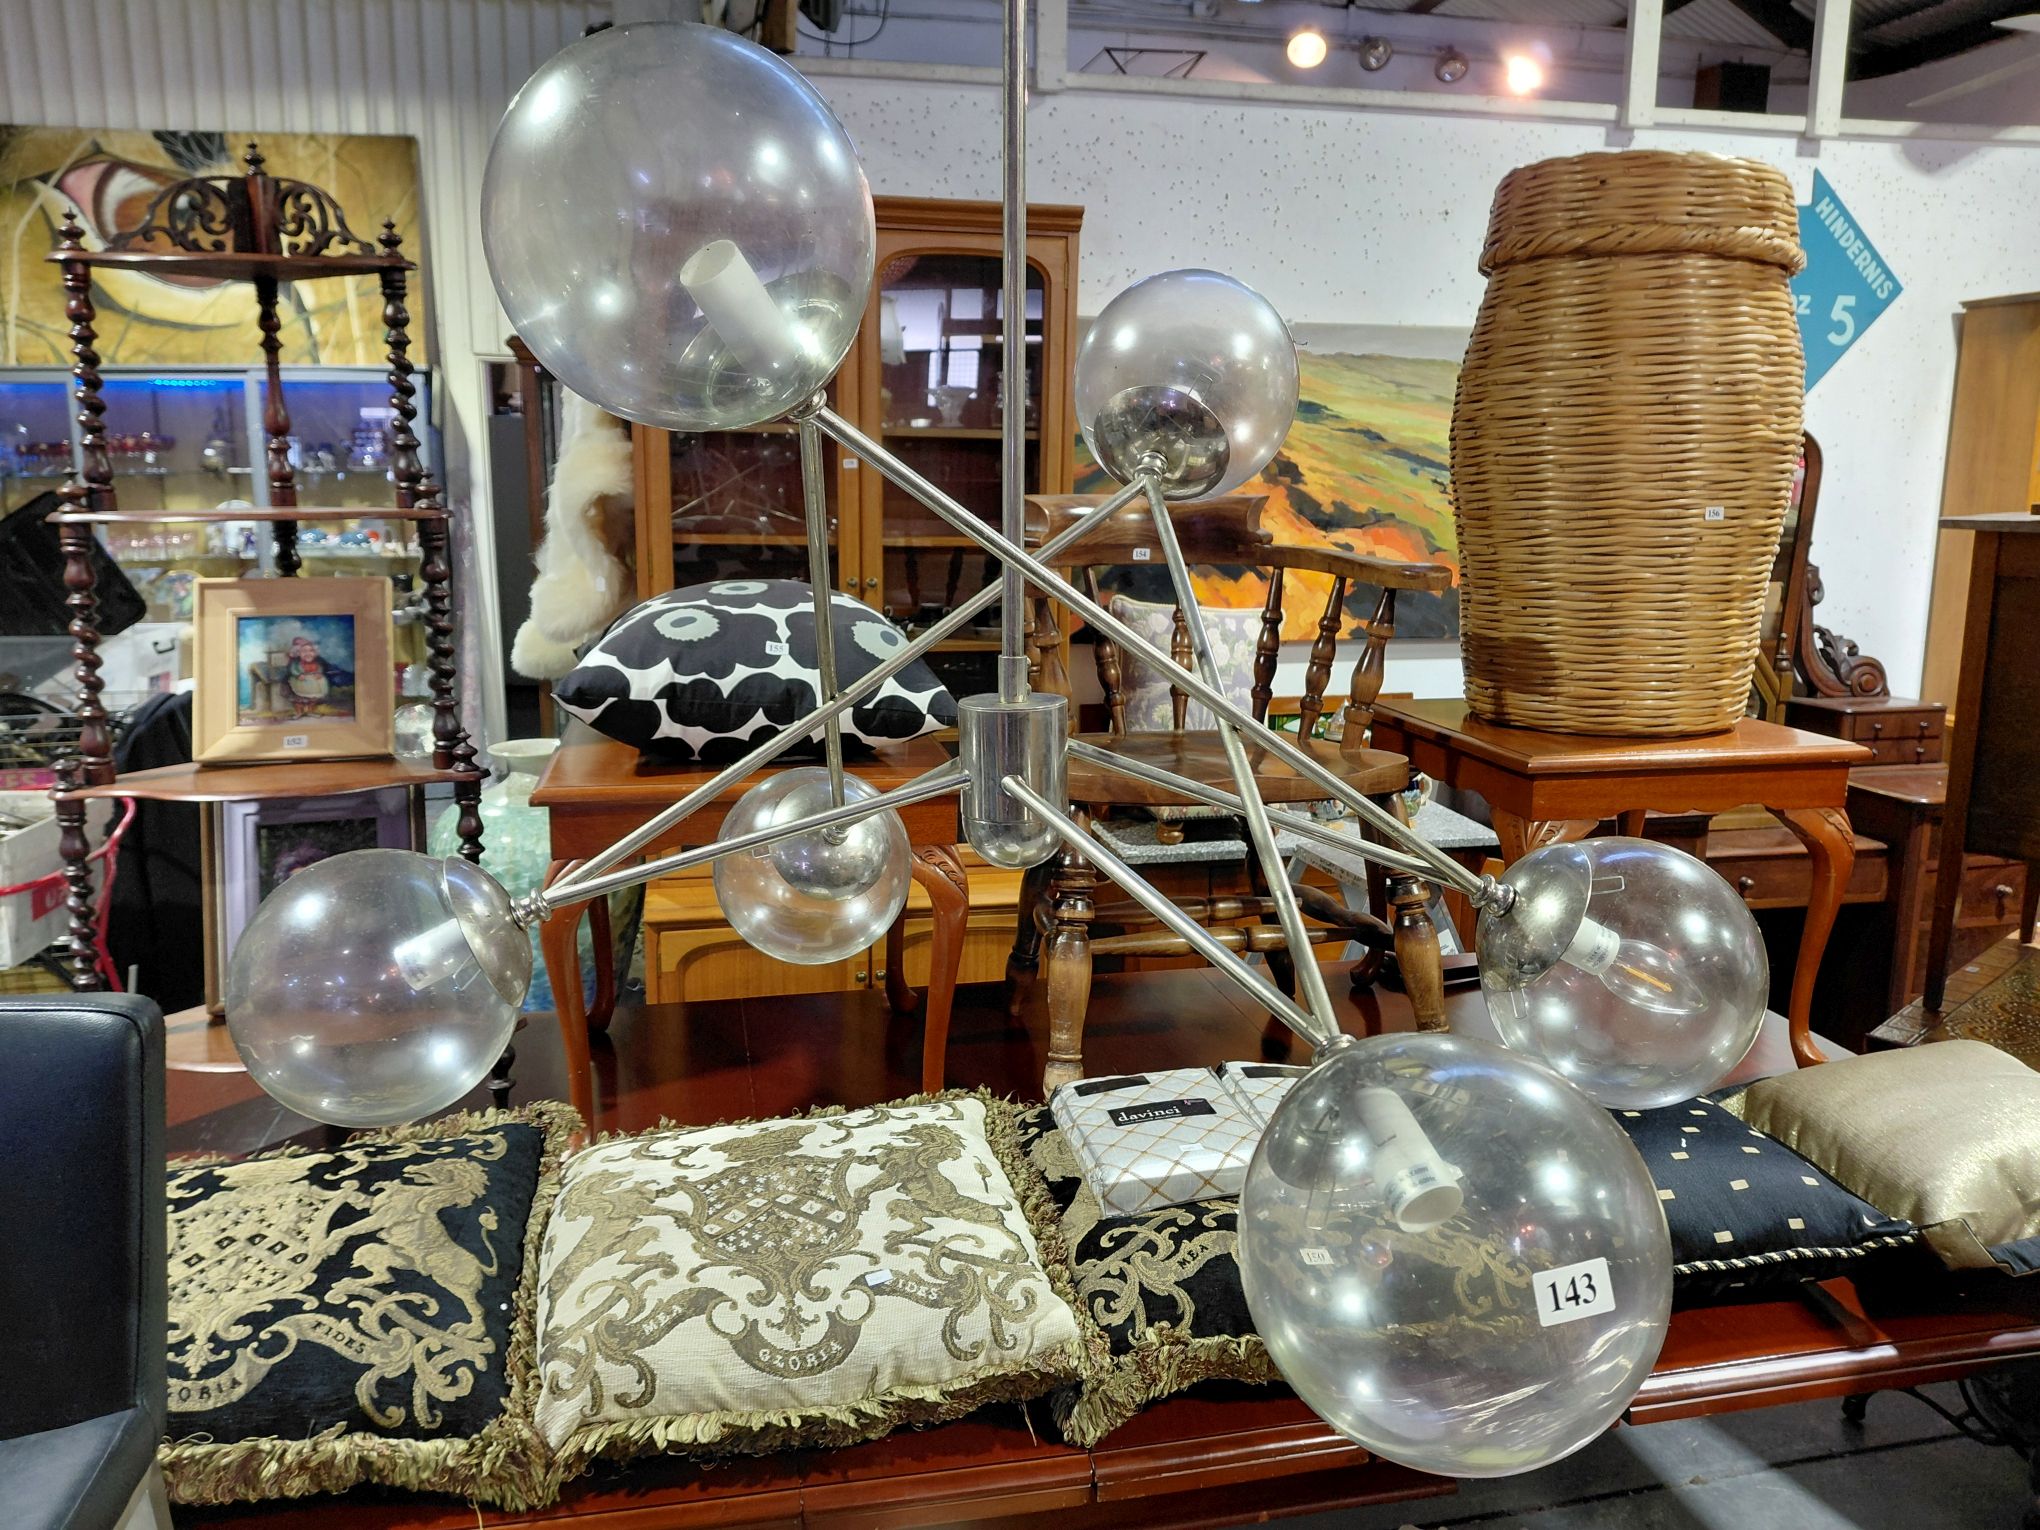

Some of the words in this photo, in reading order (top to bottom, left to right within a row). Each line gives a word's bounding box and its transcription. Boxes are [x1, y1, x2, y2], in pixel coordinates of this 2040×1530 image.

[1815, 196, 1893, 300] HINDERNIS
[1827, 294, 1856, 346] 5
[1708, 509, 1720, 518] 156
[1135, 550, 1147, 559] 154
[769, 643, 784, 653] 155
[1118, 1106, 1182, 1123] davinci
[1177, 1244, 1209, 1270] MEA
[1306, 1252, 1327, 1263] 150
[884, 1279, 941, 1300] IDES
[1546, 1272, 1597, 1313] 143
[642, 1304, 683, 1336] MEA
[311, 1320, 368, 1354] FIDES
[759, 1341, 843, 1371] GLORIA
[168, 1376, 243, 1403] ORIA
